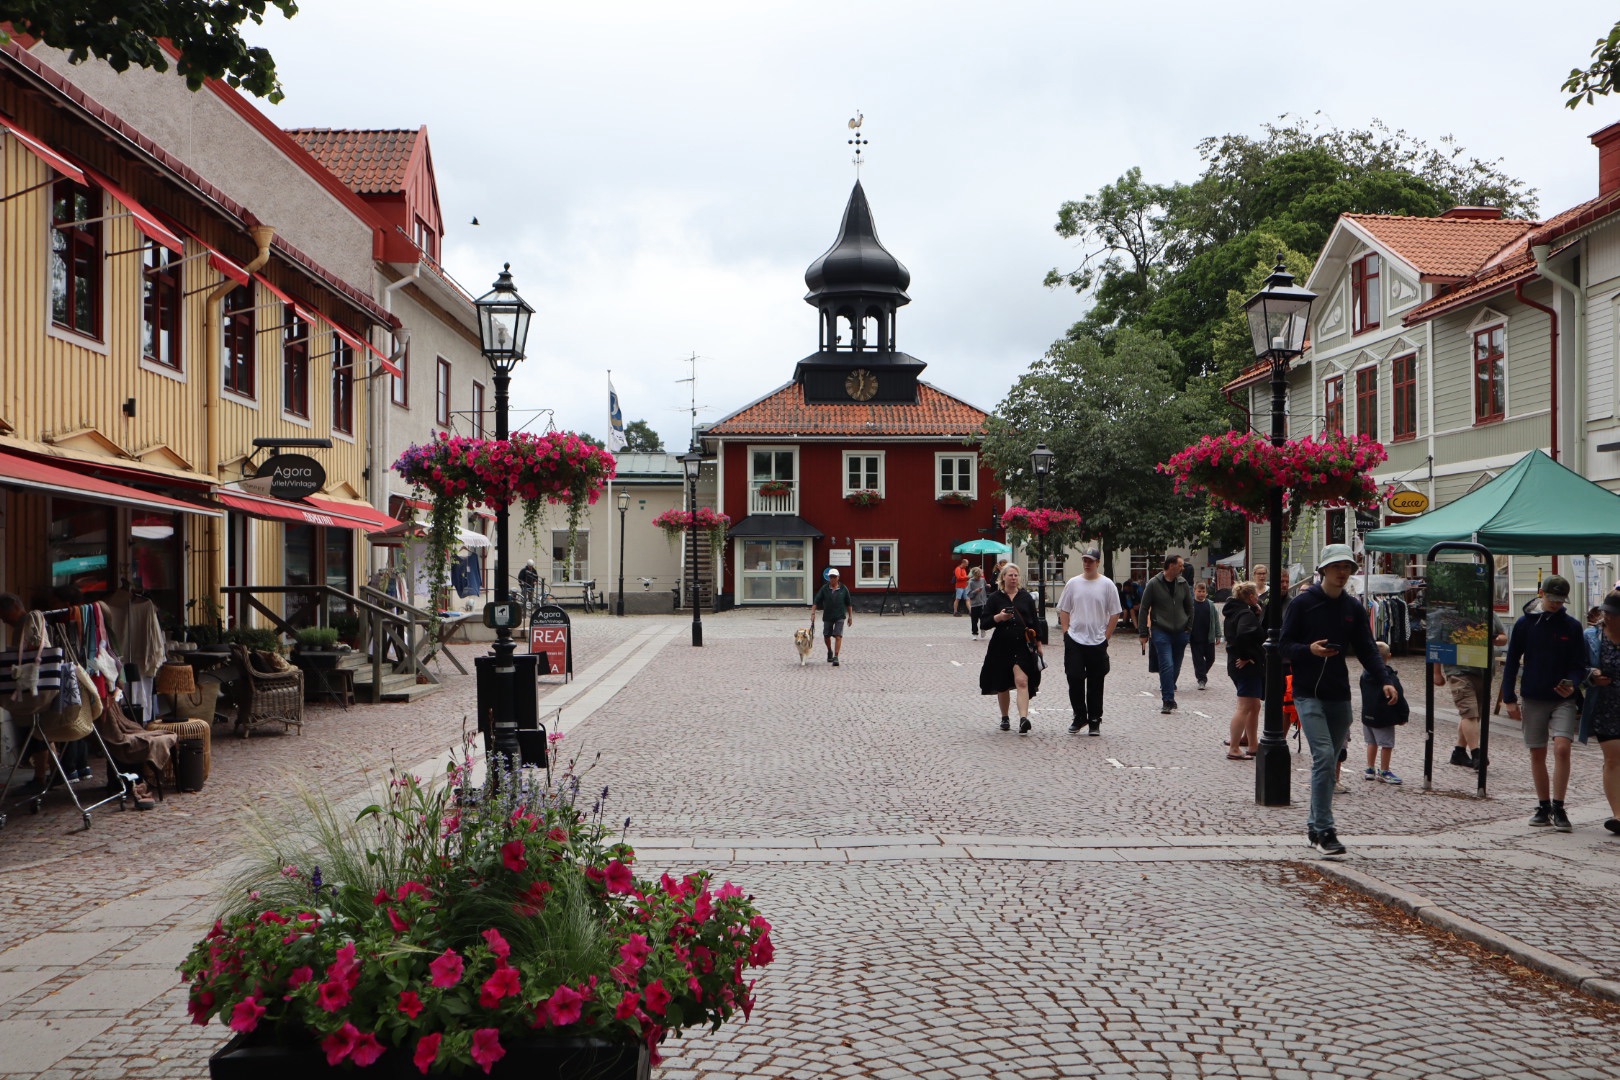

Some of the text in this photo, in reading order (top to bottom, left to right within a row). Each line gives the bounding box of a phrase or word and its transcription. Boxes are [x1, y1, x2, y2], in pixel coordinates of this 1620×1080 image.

[274, 466, 312, 478] Agora
[271, 480, 317, 488] utlet/Vintage
[533, 630, 566, 642] REA
